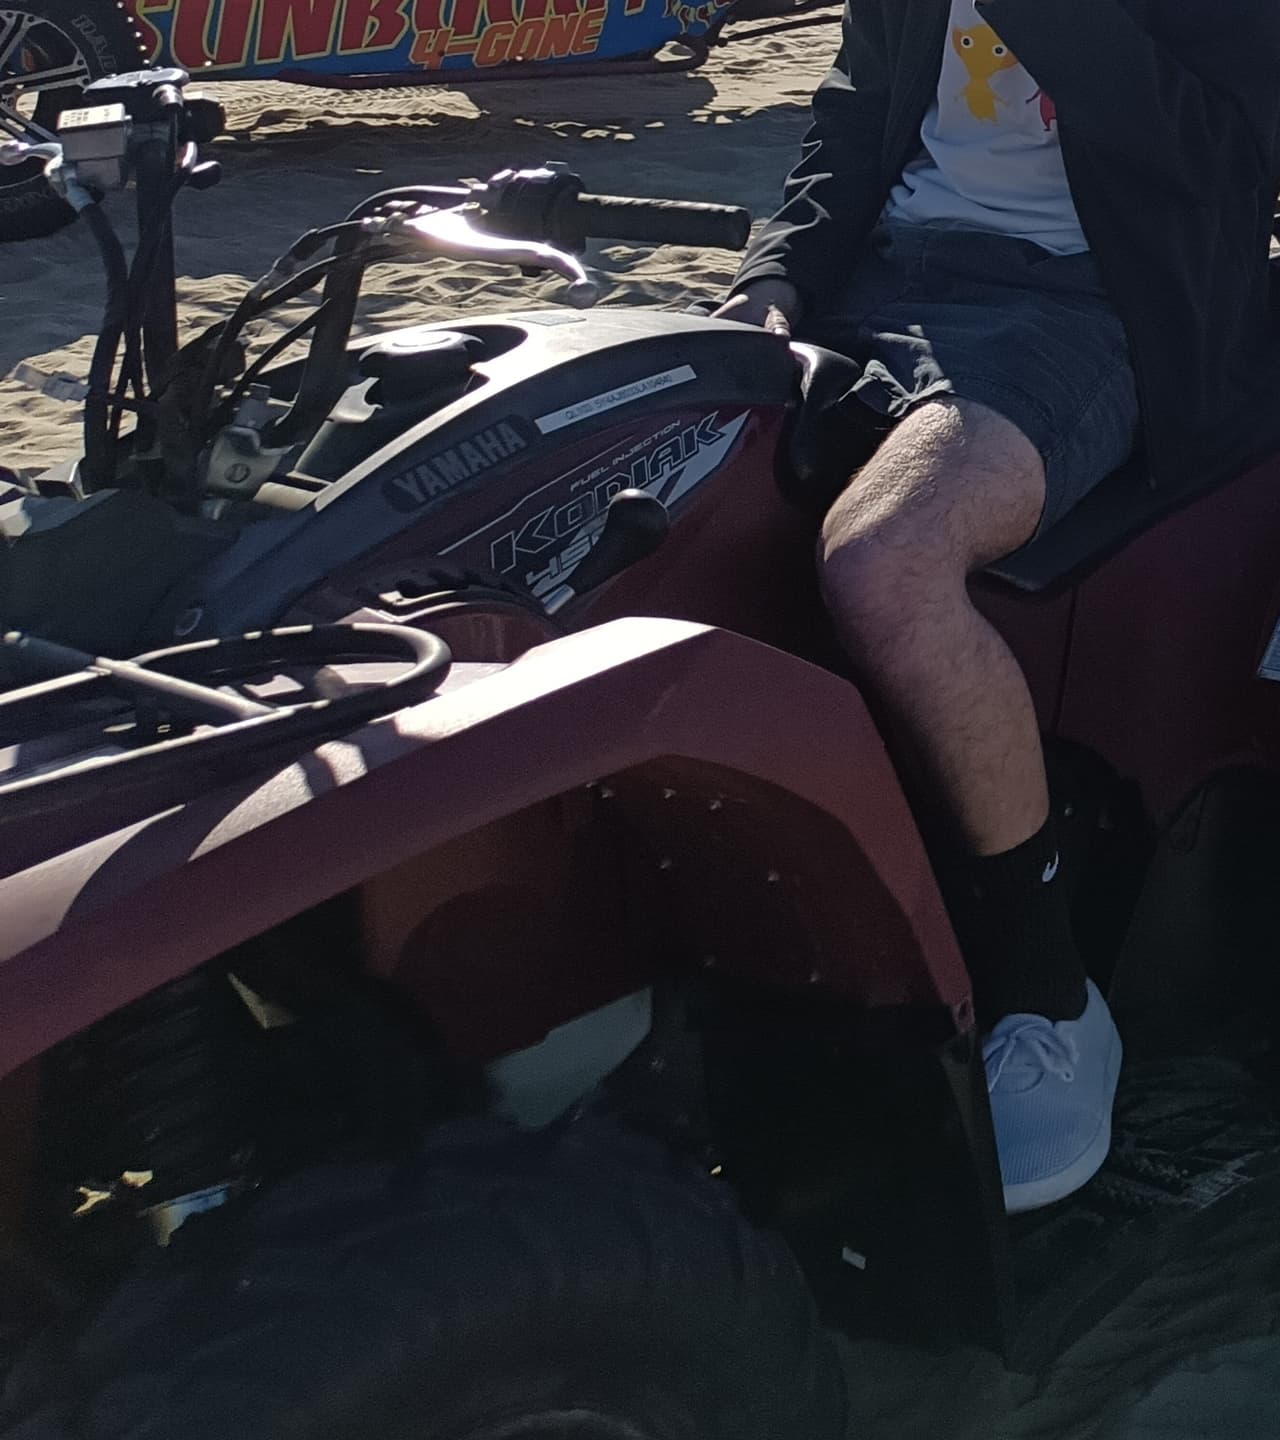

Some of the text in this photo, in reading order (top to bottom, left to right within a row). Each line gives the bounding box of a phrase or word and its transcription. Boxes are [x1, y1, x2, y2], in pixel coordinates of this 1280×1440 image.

[409, 9, 605, 69] 4-GONE
[392, 421, 527, 503] YAMAHA
[490, 409, 726, 574] KODIAK
[570, 419, 681, 492] FUEL INJECTION
